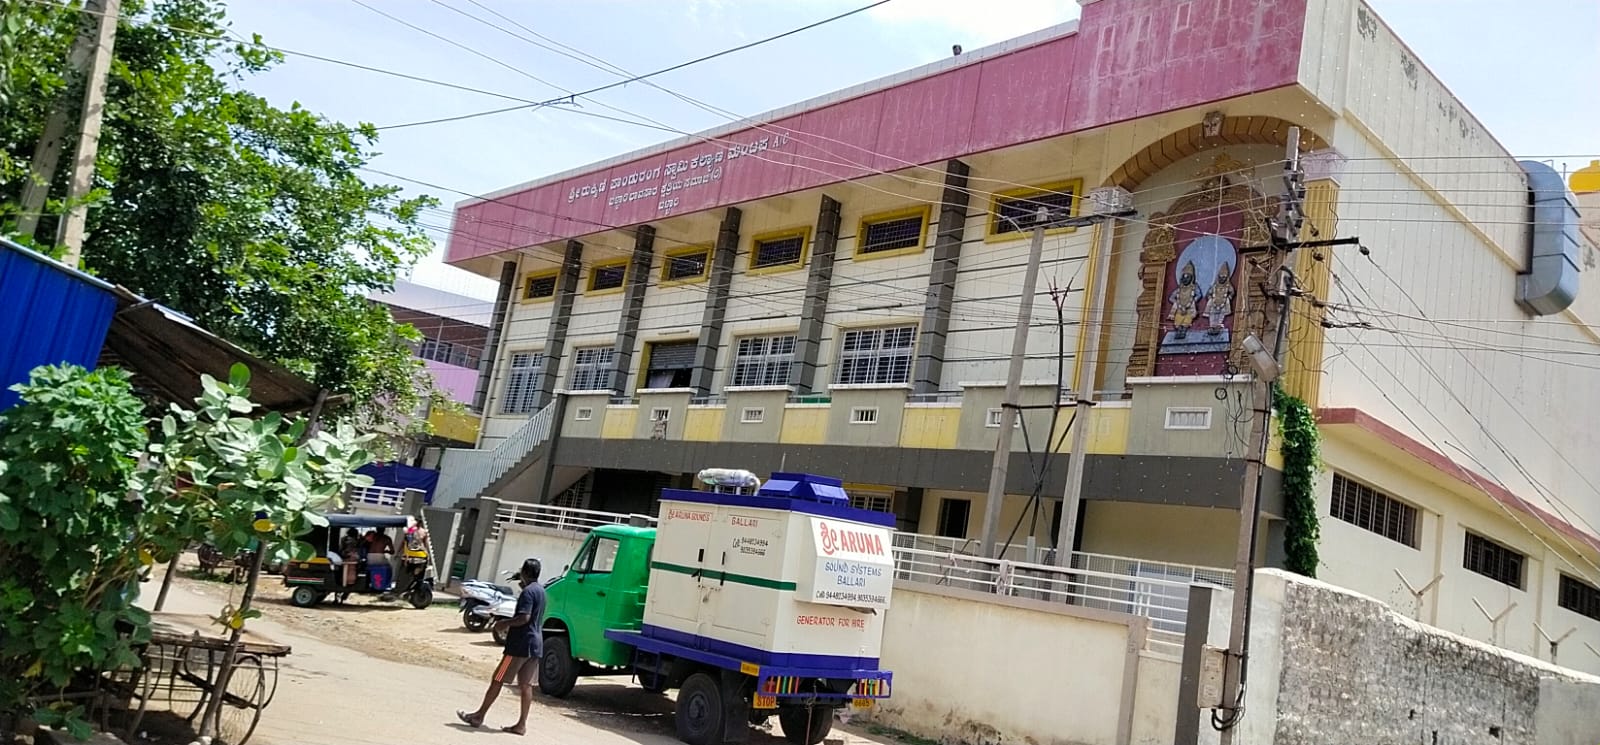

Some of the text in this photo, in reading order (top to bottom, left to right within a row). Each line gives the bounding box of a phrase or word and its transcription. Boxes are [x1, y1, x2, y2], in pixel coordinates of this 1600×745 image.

[610, 167, 661, 190] ಪಾಂಡುರಂಗ
[664, 160, 688, 180] ಸ್ವಾಮಿ
[691, 151, 723, 173] ಕಲ್ಯಾಣ
[731, 516, 759, 528] BALLARI
[840, 529, 885, 556] ARUNA
[825, 560, 882, 577] SOUND SYSTEMS
[837, 575, 866, 587] BALLARI
[797, 615, 865, 629] GENERATOR FOR HIRE
[757, 695, 776, 707] STOP
